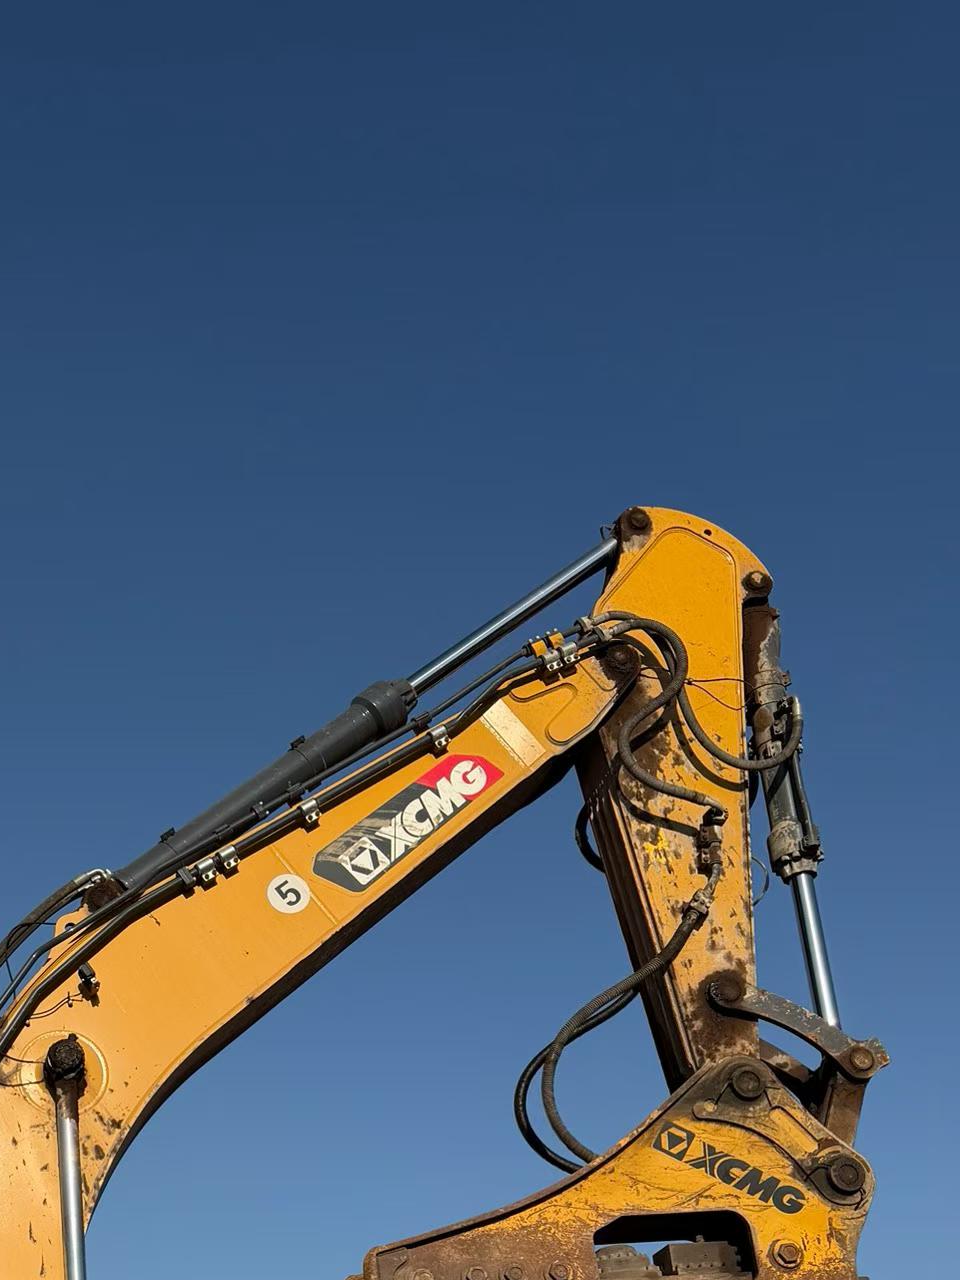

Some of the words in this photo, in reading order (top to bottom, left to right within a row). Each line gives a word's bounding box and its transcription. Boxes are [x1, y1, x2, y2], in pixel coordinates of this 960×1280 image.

[374, 760, 488, 863] XCMG
[275, 880, 302, 907] 5
[685, 1141, 806, 1214] XCMG
